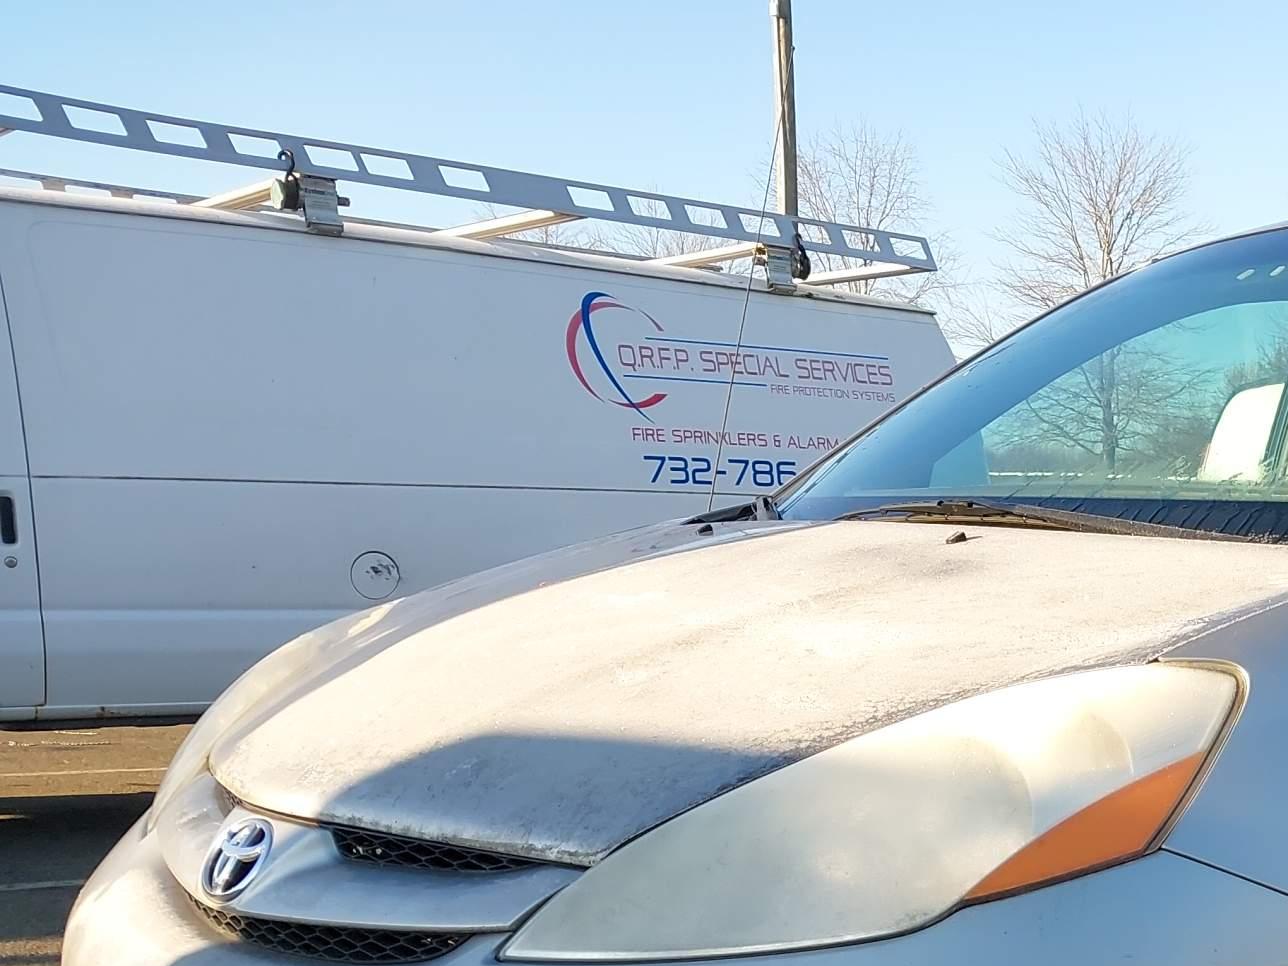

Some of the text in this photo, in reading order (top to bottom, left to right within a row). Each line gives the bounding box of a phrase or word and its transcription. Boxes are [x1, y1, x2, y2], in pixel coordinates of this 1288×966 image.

[617, 344, 893, 386] Q.R.F.P. SPECIAL SERVICES
[770, 384, 896, 403] FIRE PROTECTION SYSTEMS
[632, 427, 848, 450] FIRE SPRINKLERS & ALARM
[643, 455, 797, 488] 732-786
